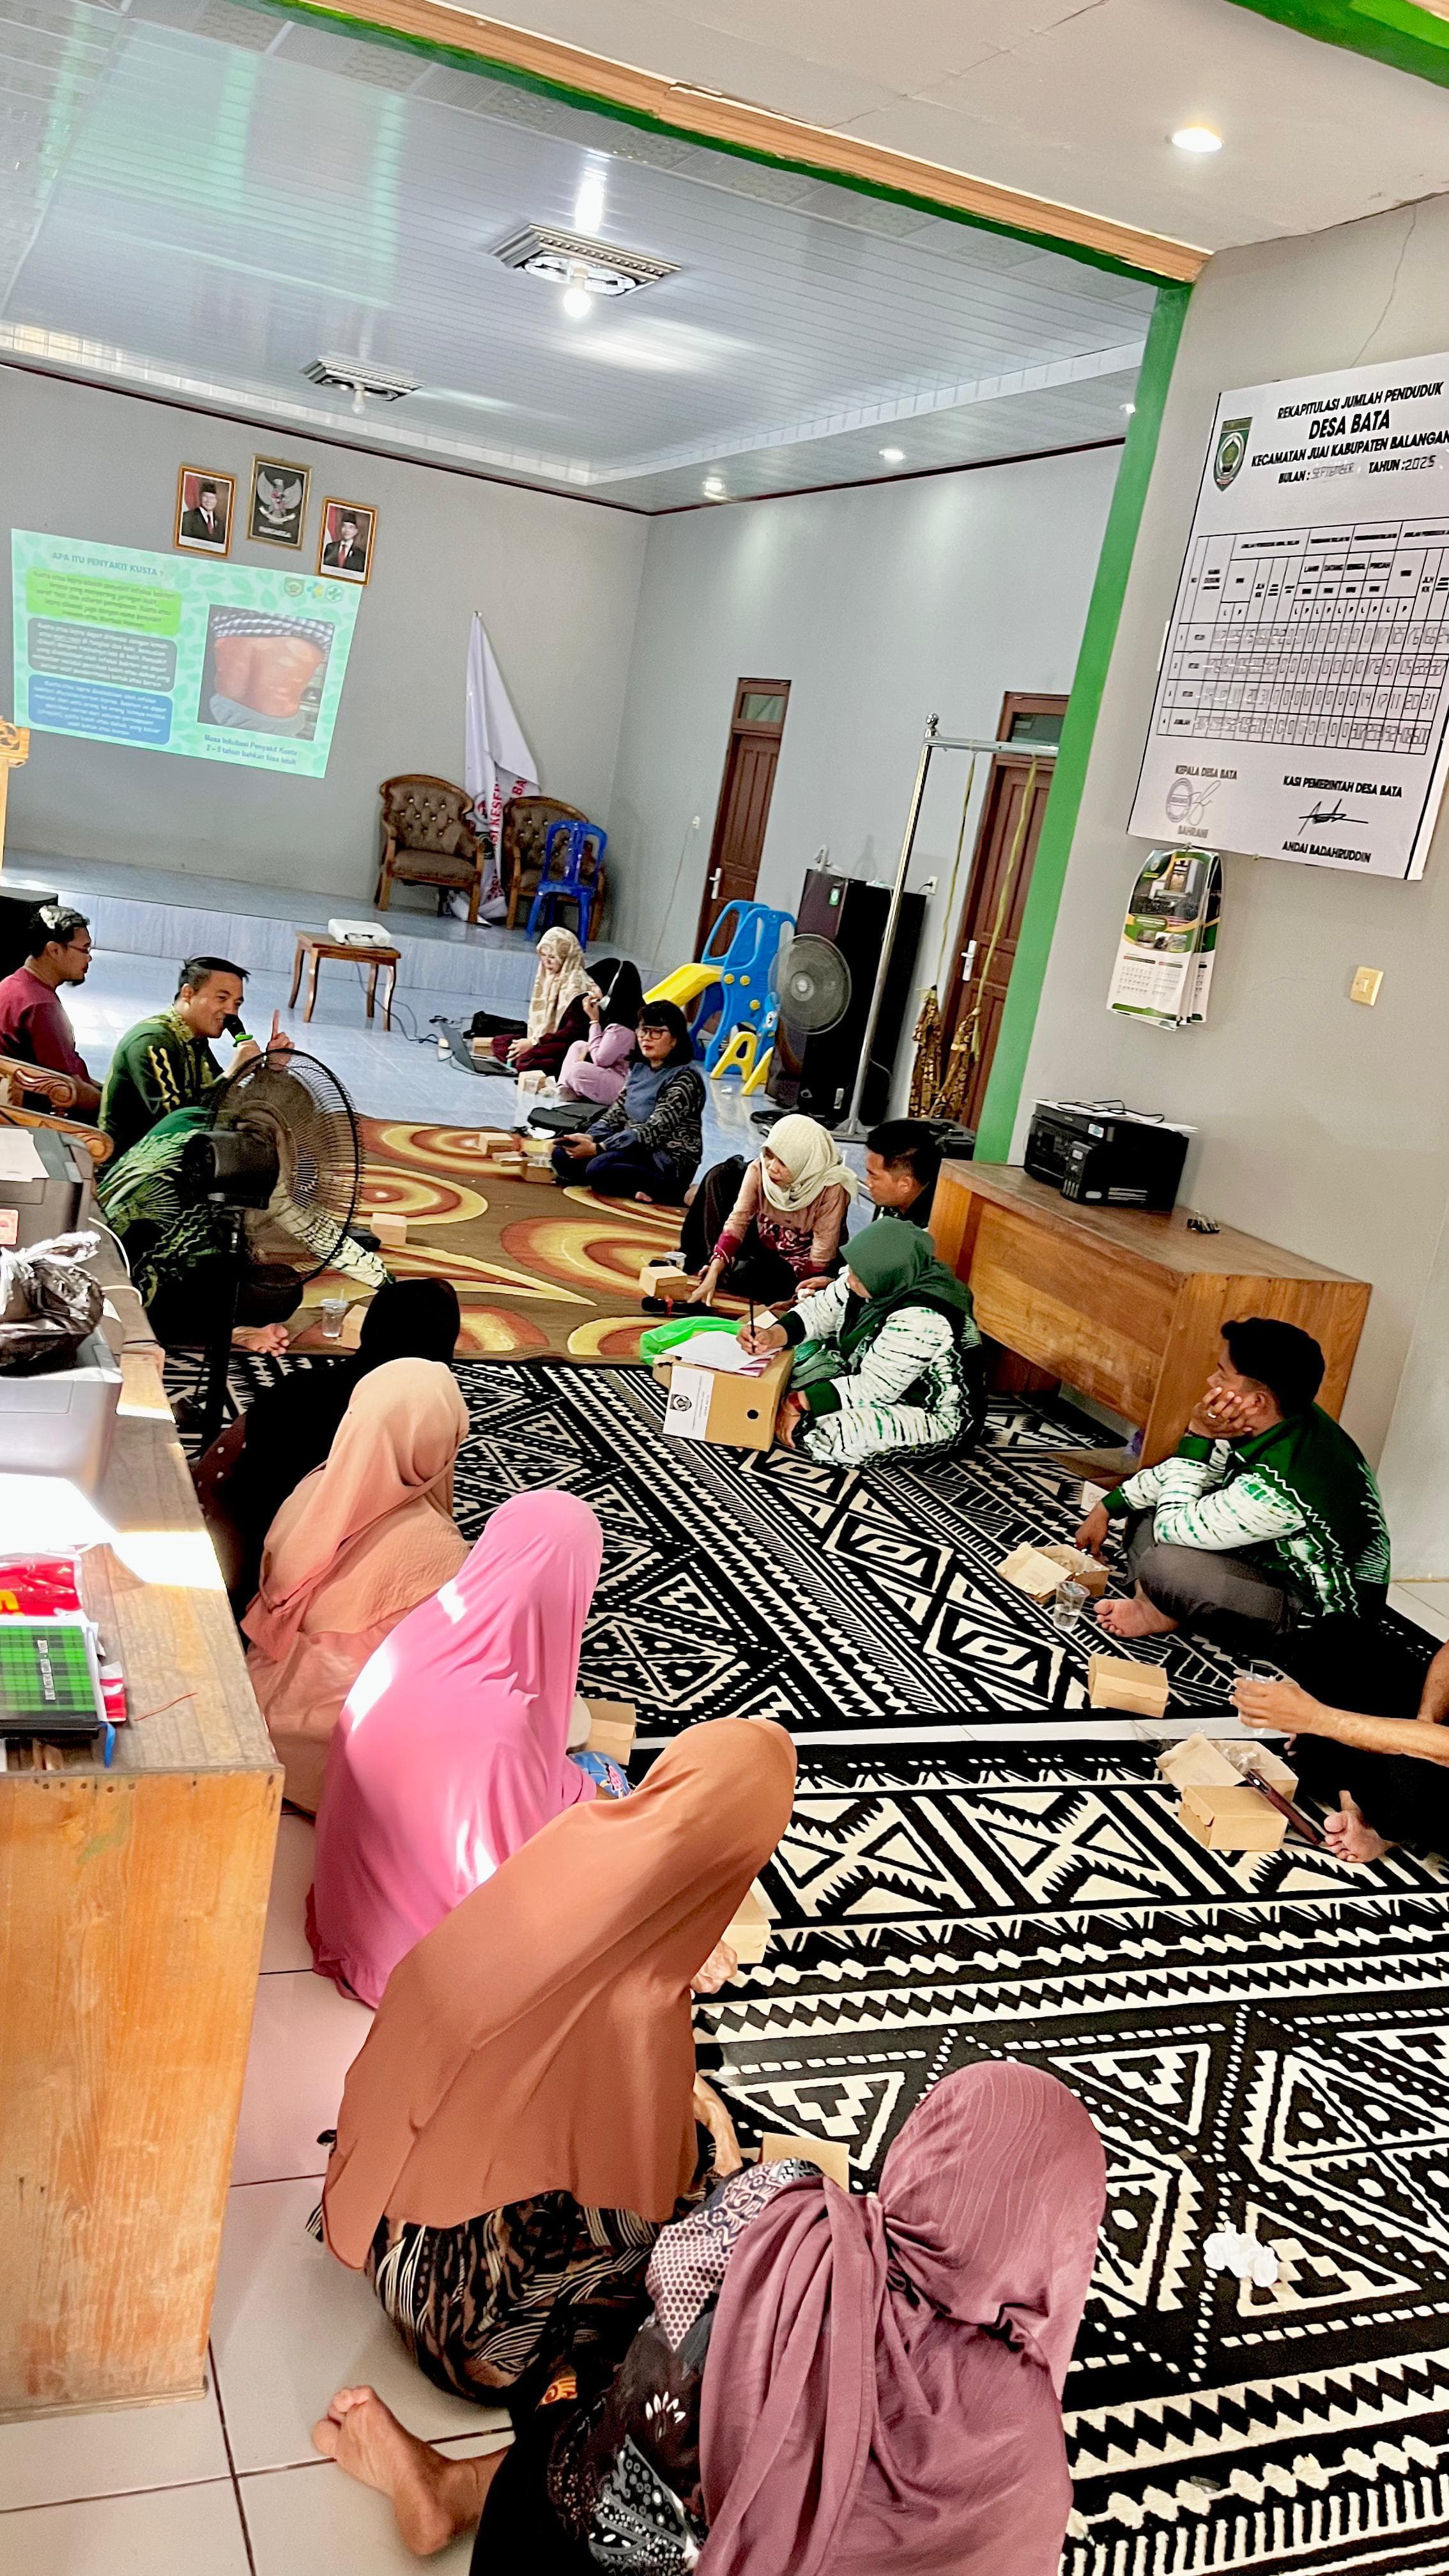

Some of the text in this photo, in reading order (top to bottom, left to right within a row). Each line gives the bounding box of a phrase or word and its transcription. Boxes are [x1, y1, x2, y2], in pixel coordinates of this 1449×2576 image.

[1277, 381, 1445, 419] REKAPITULASI JUMLAH PENDUDUK
[1308, 409, 1390, 440] DESA BATA
[1252, 430, 1449, 467] KECAMATAN JUAI KABUPATEN BALANGAN
[52, 552, 70, 561] APA
[72, 555, 85, 564] ITU
[86, 556, 128, 571] PENYAKIT
[130, 562, 157, 576] KUSTA
[204, 734, 221, 743] Masa
[250, 741, 277, 753] Penyakit
[279, 747, 297, 756] Kusta
[222, 747, 240, 756] tahun
[241, 750, 264, 760] bahkan
[266, 755, 280, 763] bisa
[280, 757, 296, 765] lebih
[1283, 776, 1402, 798] KASI PEMERINTAH DESA BATA
[1282, 841, 1308, 854] ANDAI
